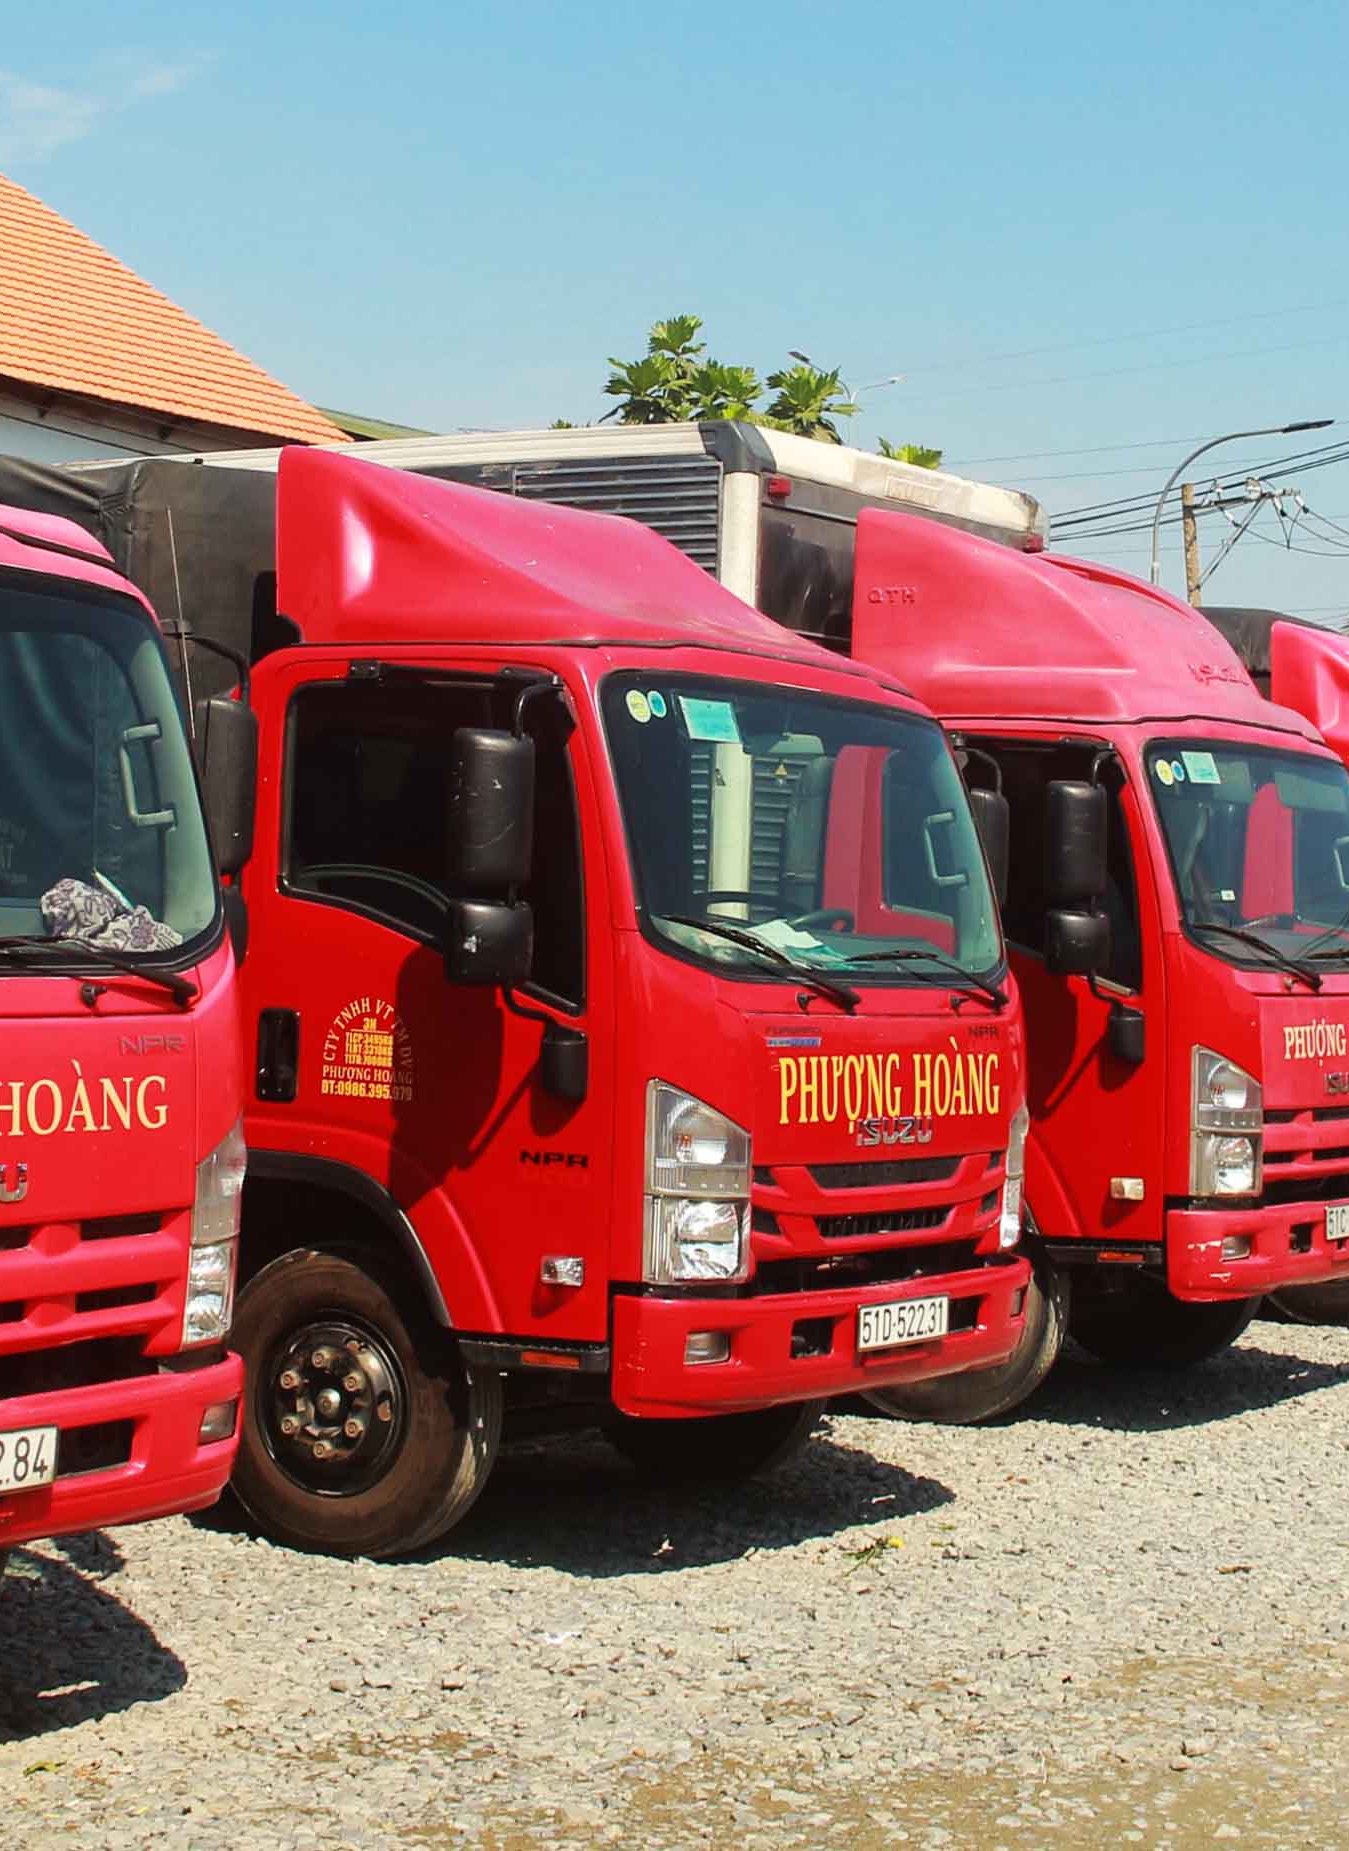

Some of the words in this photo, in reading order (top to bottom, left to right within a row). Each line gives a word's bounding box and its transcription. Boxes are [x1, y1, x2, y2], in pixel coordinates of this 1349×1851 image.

[323, 1030, 339, 1062] CTY
[333, 996, 371, 1029] TNHH
[376, 999, 394, 1020] VT
[1283, 1018, 1347, 1067] PHƯỢNG
[779, 1054, 902, 1134] PHƯỢNG
[913, 1036, 1000, 1118] HOÀNG
[856, 1117, 932, 1146] ISUZU
[520, 1149, 588, 1169] NPR
[862, 1300, 944, 1344] 51D-522.31
